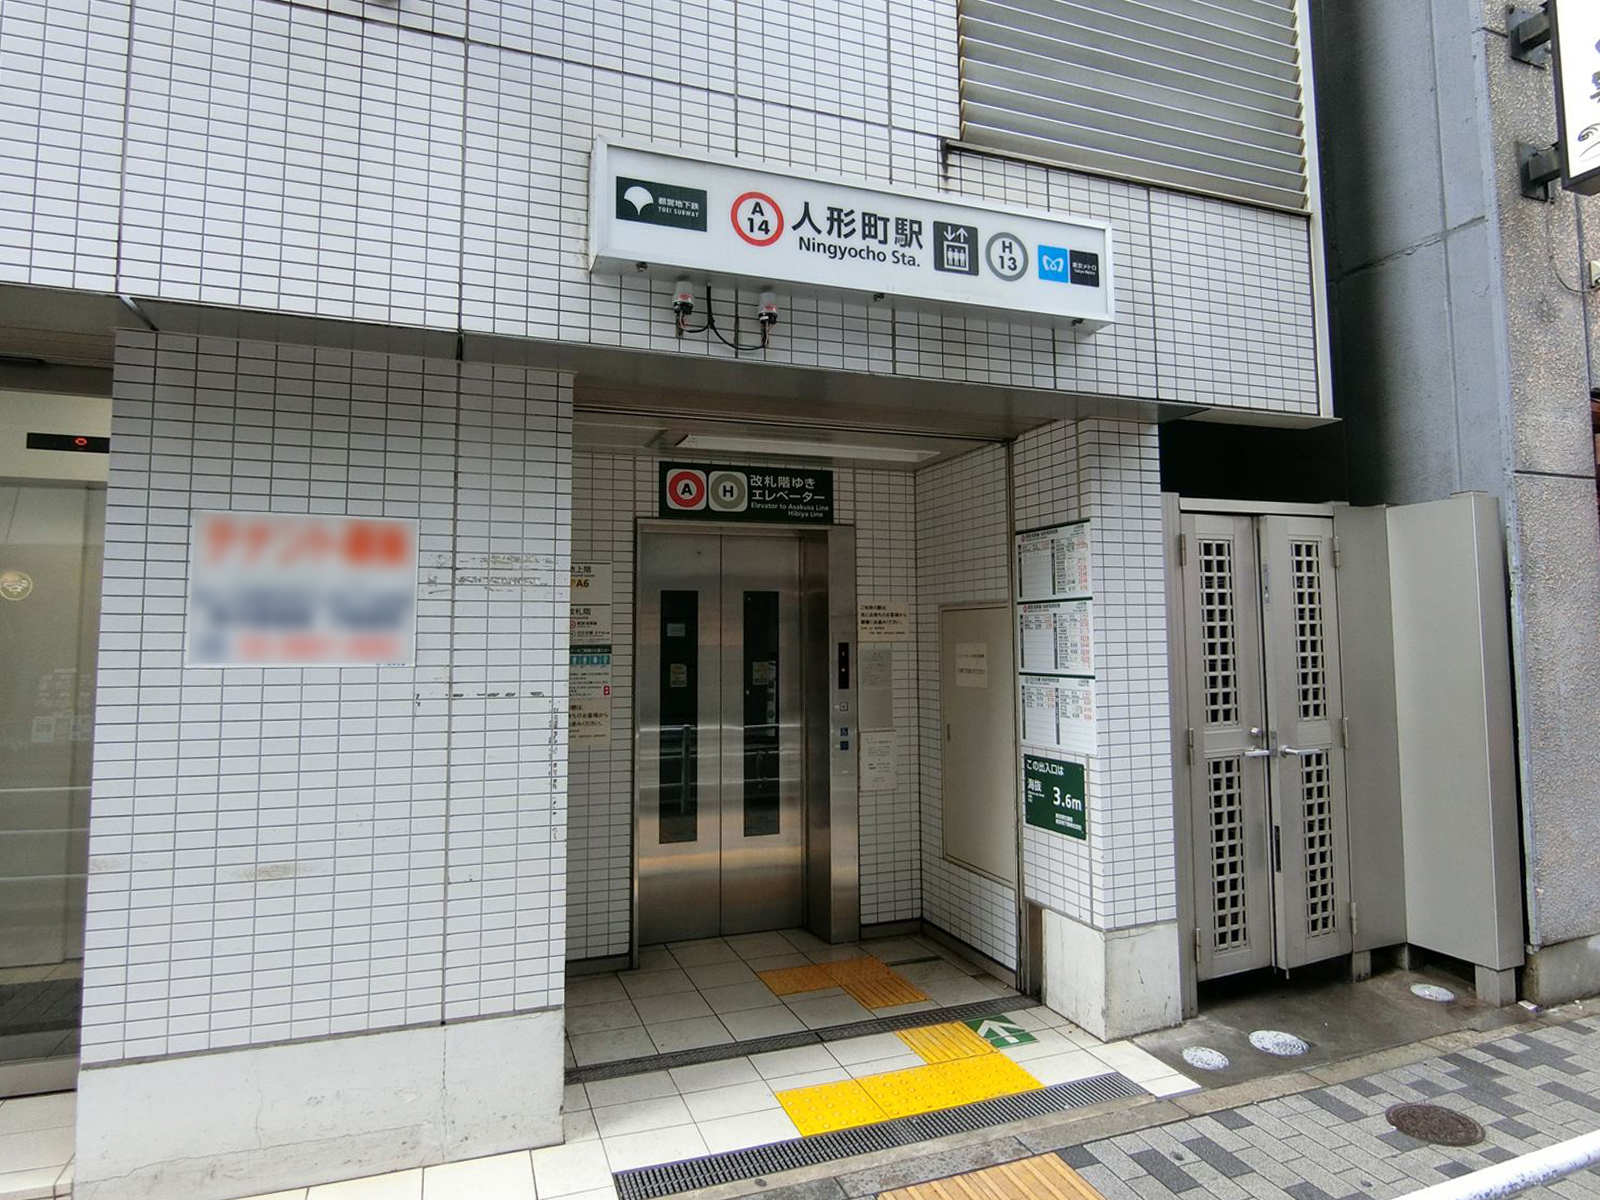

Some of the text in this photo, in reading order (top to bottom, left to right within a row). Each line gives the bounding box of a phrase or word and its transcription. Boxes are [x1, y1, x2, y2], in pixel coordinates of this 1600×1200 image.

[658, 197, 700, 210] 都営地下鉄
[751, 202, 765, 216] A
[658, 206, 700, 218] TOEI SUBWAY
[747, 218, 771, 236] 14
[791, 201, 924, 251] 人形町駅
[798, 236, 921, 267] Ningyocho Sta.
[1002, 240, 1014, 254] H
[998, 254, 1018, 271] 13
[750, 474, 816, 490] 改札階ゆき
[681, 483, 693, 496] A
[722, 485, 734, 498] H
[751, 490, 826, 503] エレベーター
[751, 502, 778, 510] Elevator
[788, 510, 809, 518] Hibiya
[576, 579, 590, 588] A6
[1026, 759, 1065, 777] この出入口は
[1027, 777, 1042, 792] 海抜
[1052, 786, 1082, 812] 3.6m
